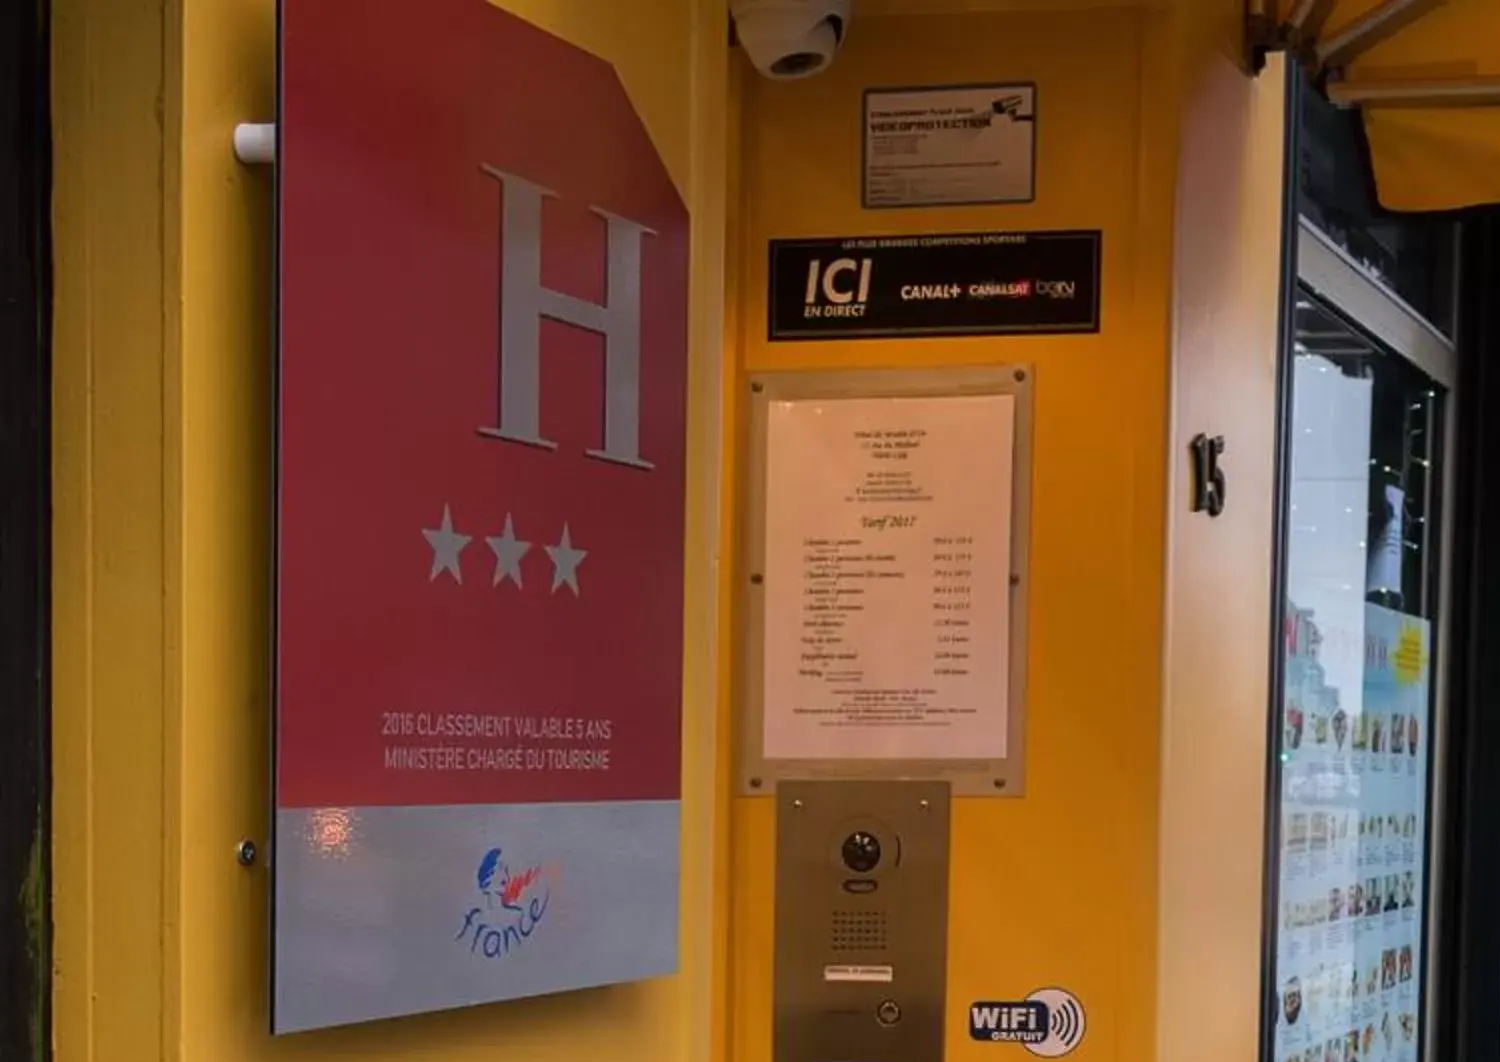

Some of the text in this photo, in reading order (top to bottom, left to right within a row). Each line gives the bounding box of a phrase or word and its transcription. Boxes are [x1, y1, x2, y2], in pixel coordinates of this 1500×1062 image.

[805, 258, 872, 303] ICI
[901, 284, 961, 299] CANAL+
[475, 162, 657, 470] H
[804, 304, 866, 318] EN DIRECT
[889, 516, 917, 529] 2017
[382, 712, 612, 740] 2016 CLASSEMENT VALABLE 5 ANS
[527, 749, 545, 770] DU
[549, 750, 610, 770] TOURISME
[972, 1007, 1036, 1029] WiFi
[992, 1031, 1044, 1041] GRATUIT
